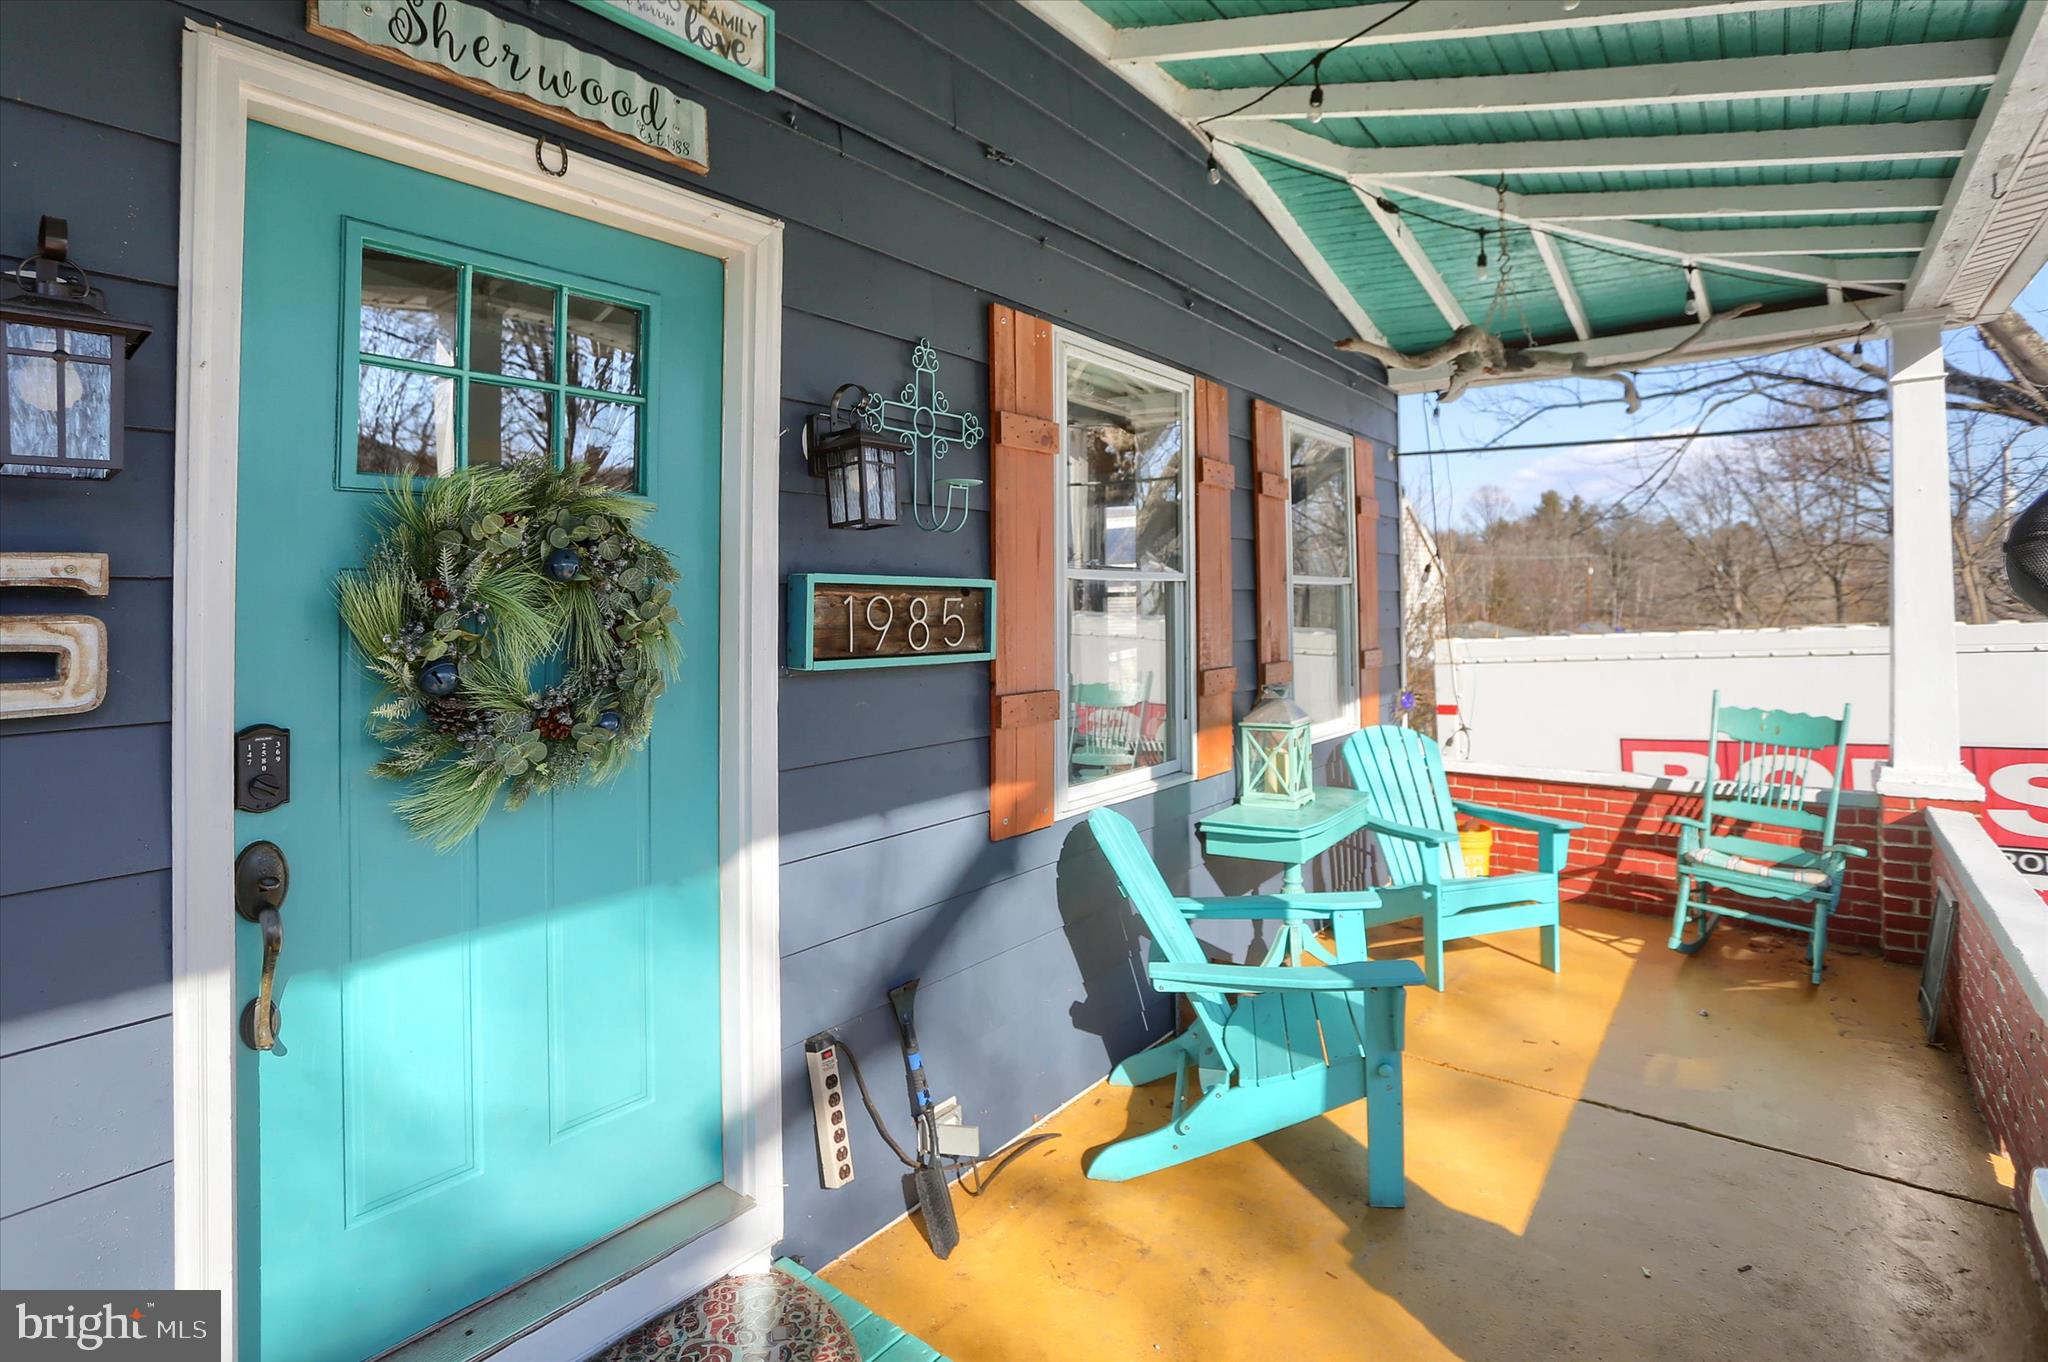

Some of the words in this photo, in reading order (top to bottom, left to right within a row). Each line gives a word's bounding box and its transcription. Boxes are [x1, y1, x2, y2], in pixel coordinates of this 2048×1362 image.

[684, 5, 752, 67] love
[696, 0, 758, 40] FAMILY
[388, 0, 667, 132] Sherwood
[843, 595, 966, 653] 1985
